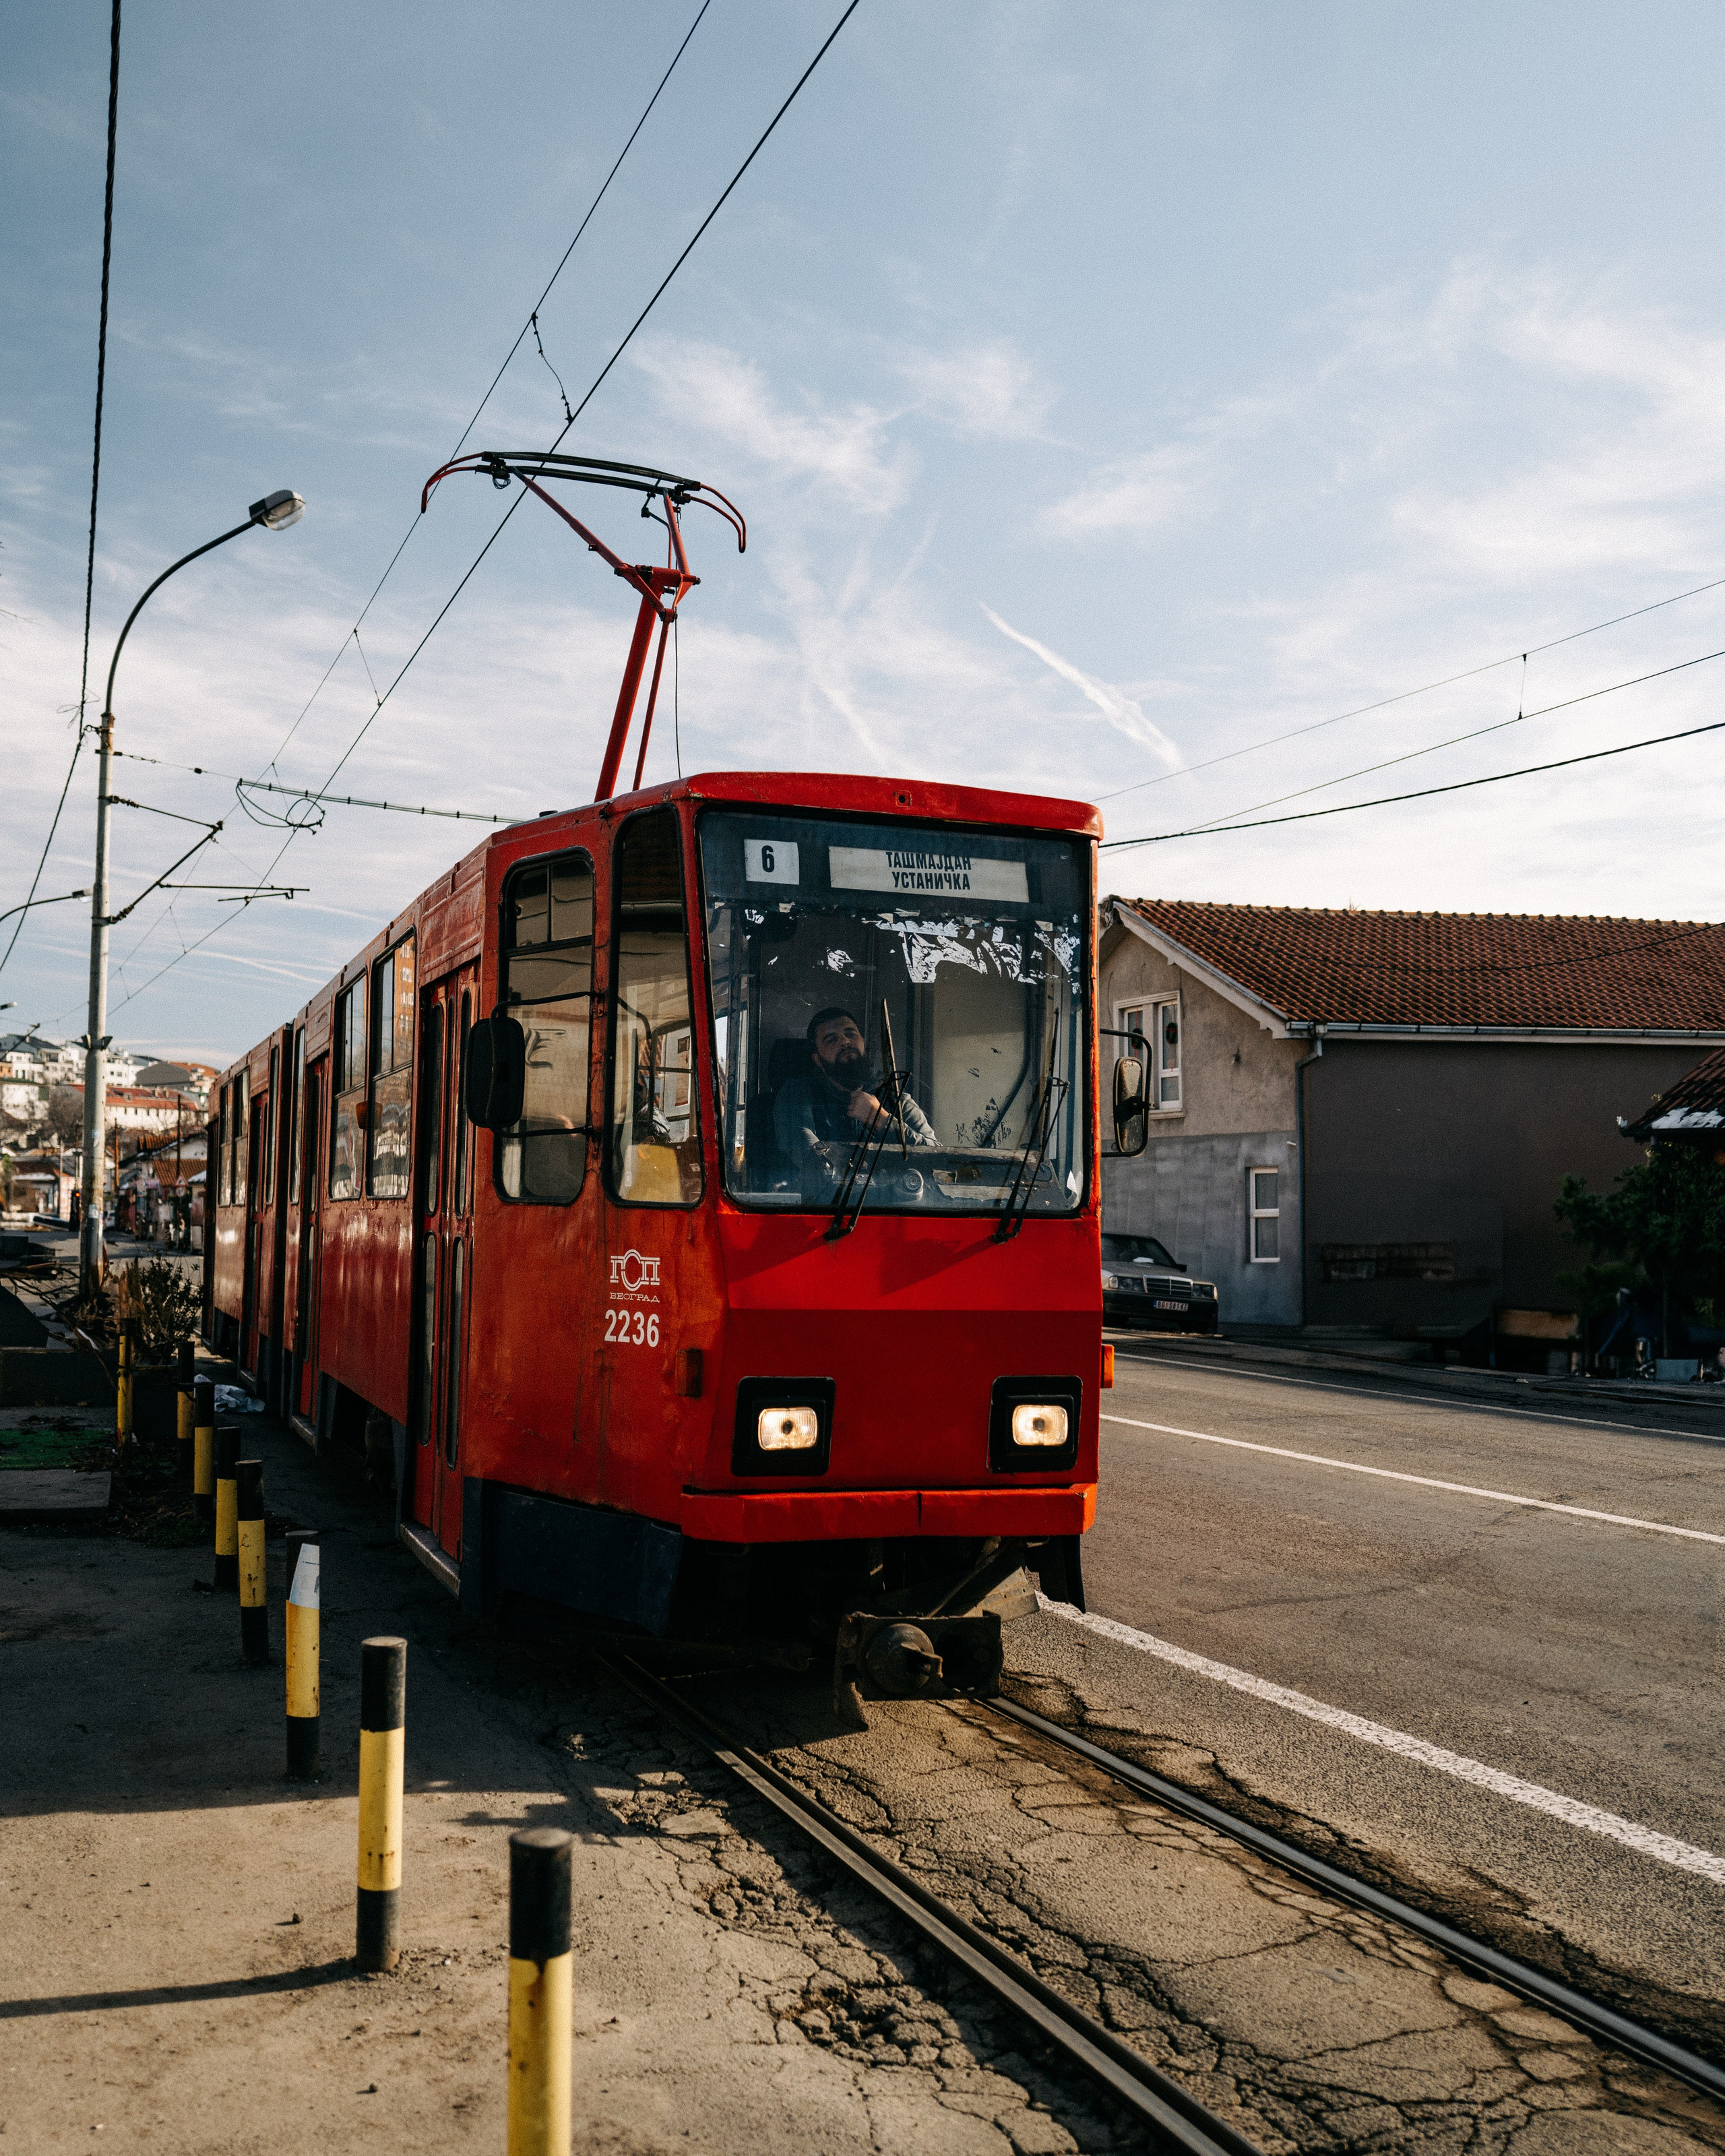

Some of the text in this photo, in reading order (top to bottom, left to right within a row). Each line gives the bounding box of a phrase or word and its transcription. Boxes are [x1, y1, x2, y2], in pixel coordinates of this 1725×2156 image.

[761, 844, 775, 873] 6
[885, 851, 972, 872] ТАШМАЈДАН
[891, 871, 970, 890] УСТАНИЧКА
[610, 1249, 660, 1291] ГСП
[604, 1309, 660, 1348] 2236
